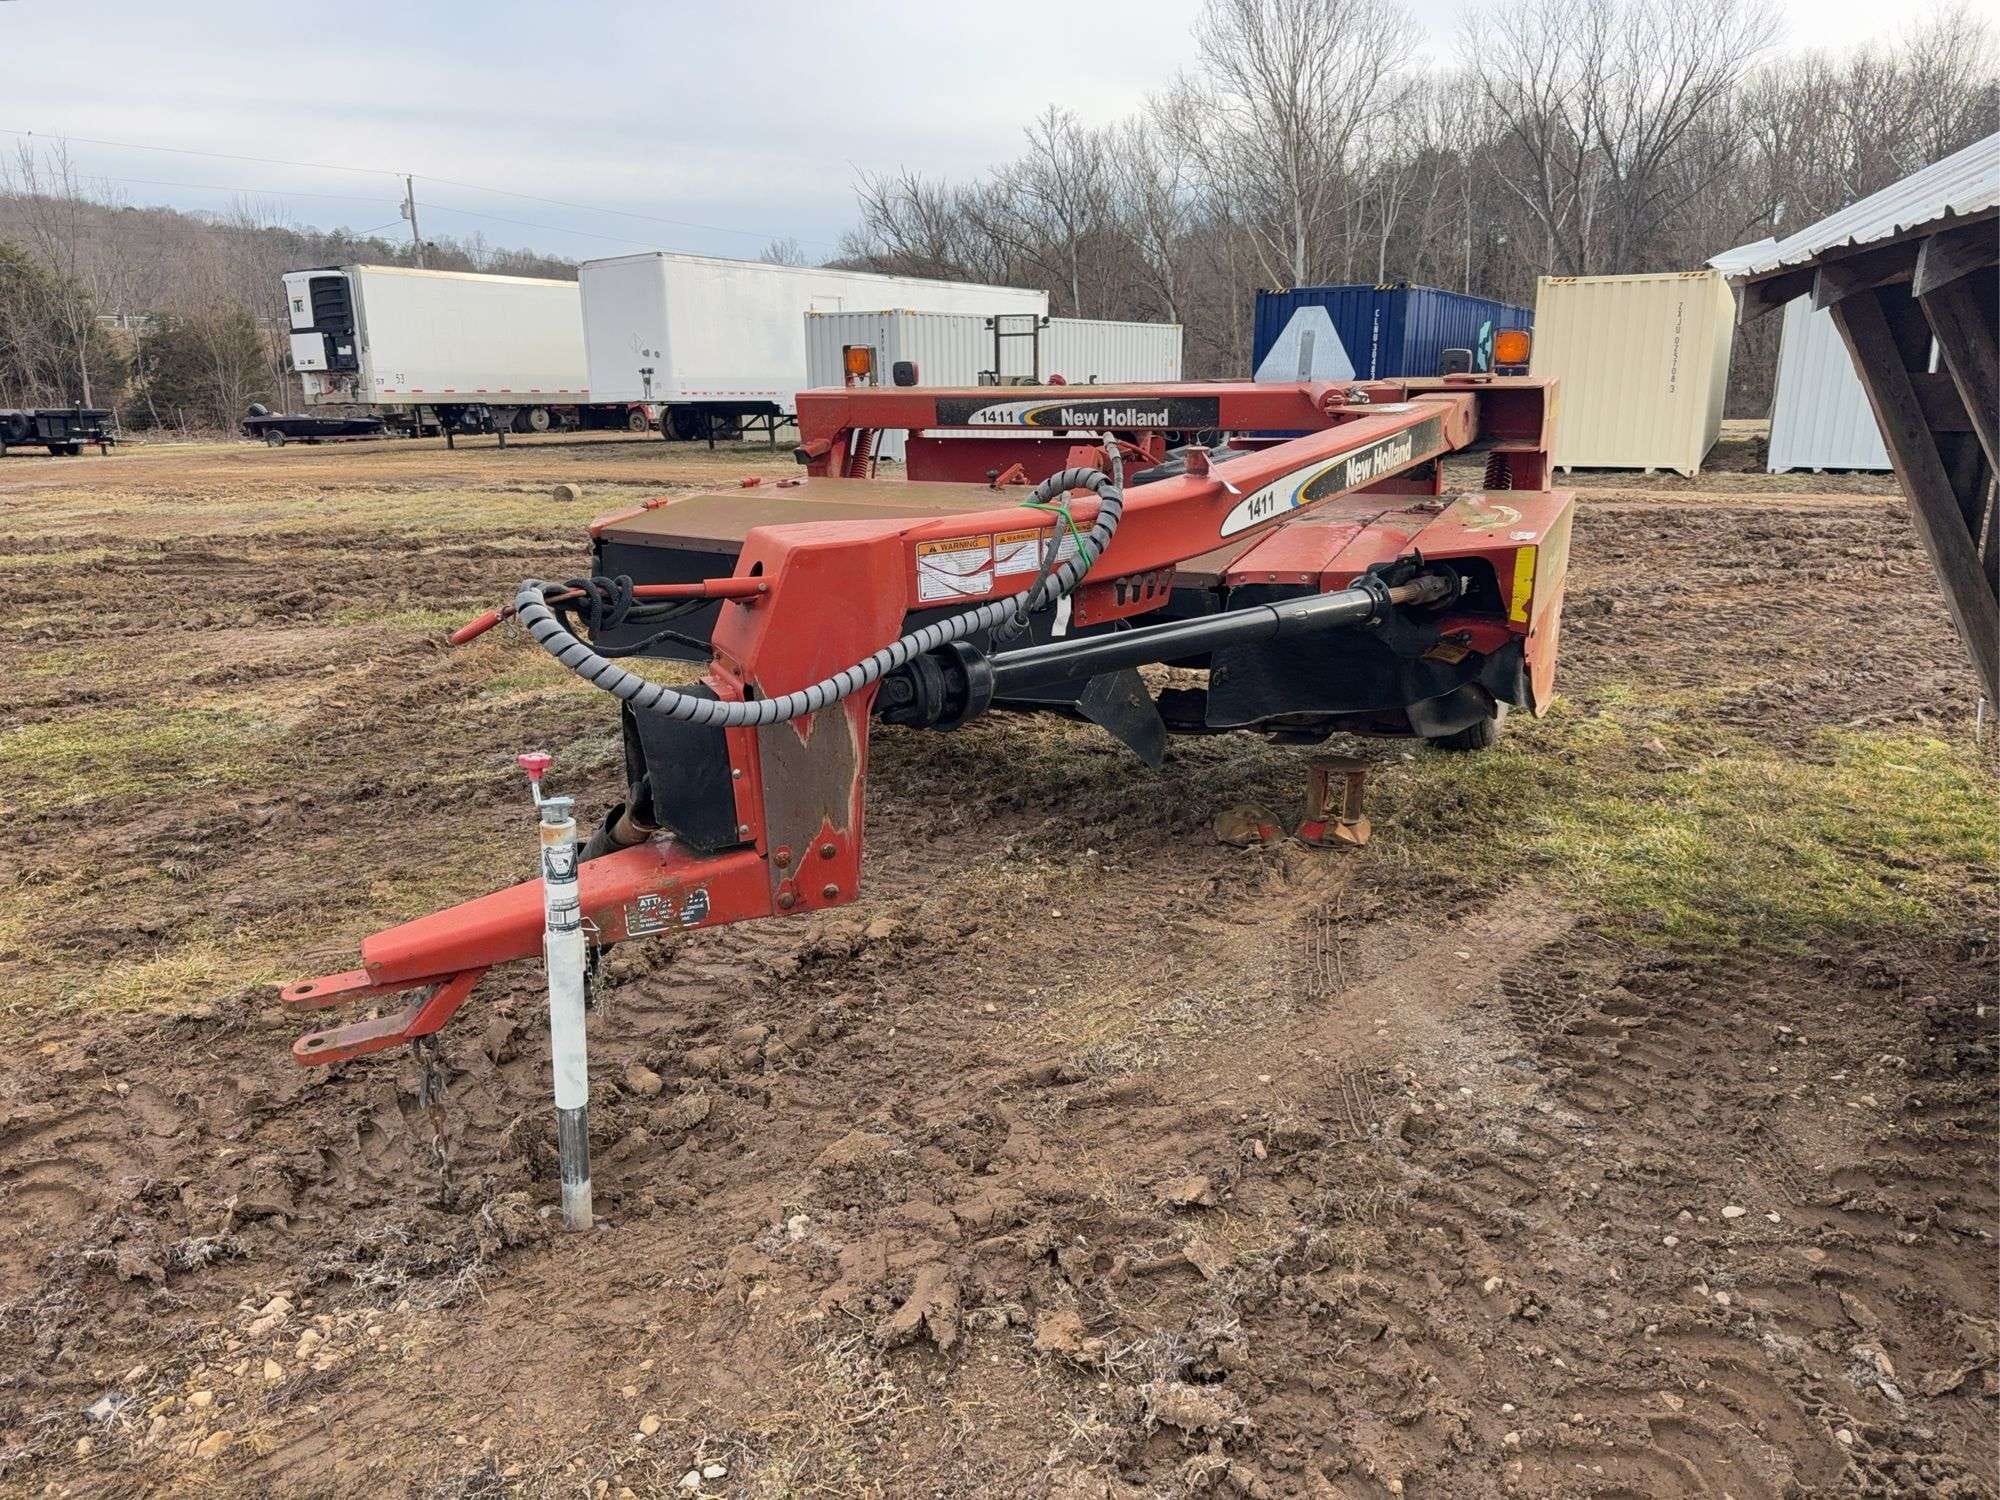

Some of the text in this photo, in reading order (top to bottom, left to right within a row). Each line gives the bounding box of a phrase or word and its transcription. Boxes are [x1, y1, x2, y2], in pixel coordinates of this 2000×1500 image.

[980, 407, 1169, 427] 1411 New Holland
[1247, 435, 1413, 521] 1411 New Holland
[940, 540, 979, 551] WARNING
